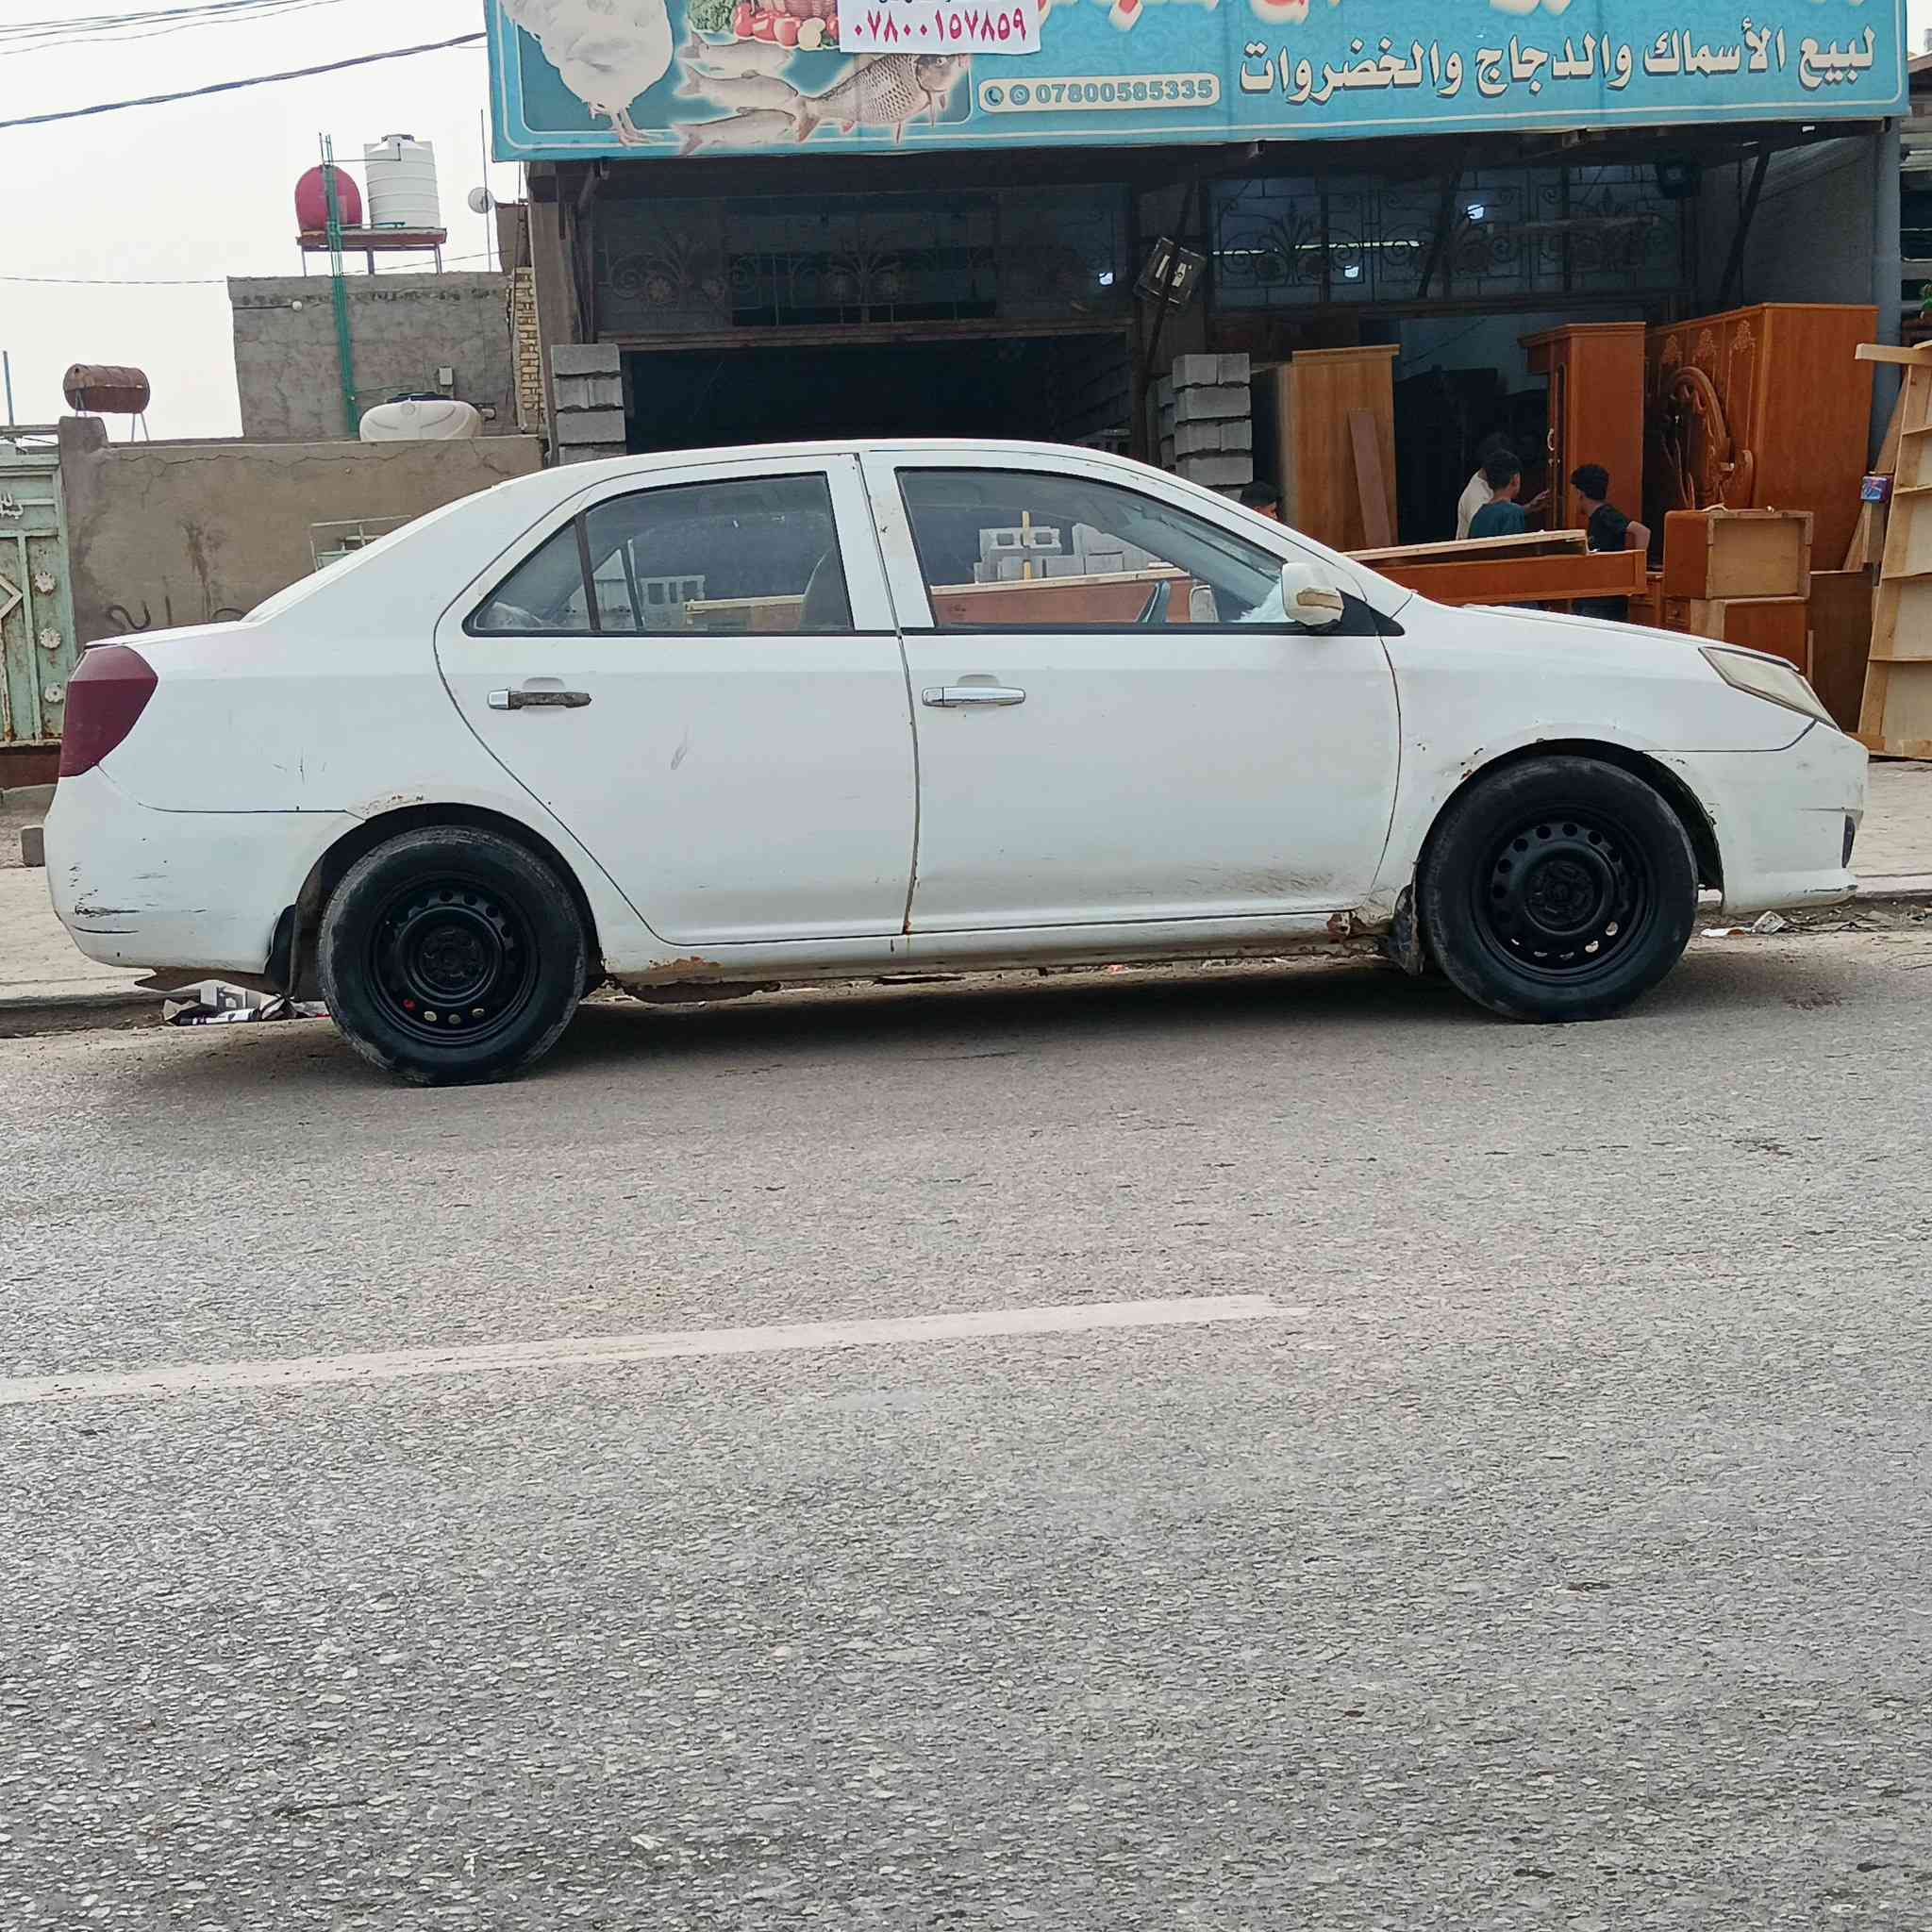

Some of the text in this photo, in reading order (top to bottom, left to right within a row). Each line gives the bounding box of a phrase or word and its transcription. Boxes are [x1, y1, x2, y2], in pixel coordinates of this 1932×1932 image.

[854, 8, 1026, 42] ٠٧٨٠٠١٥٧٨٥٩
[1240, 16, 1875, 106] لبيع الأسماك والدجاج والخضروات
[1035, 79, 1213, 104] 07800585335
